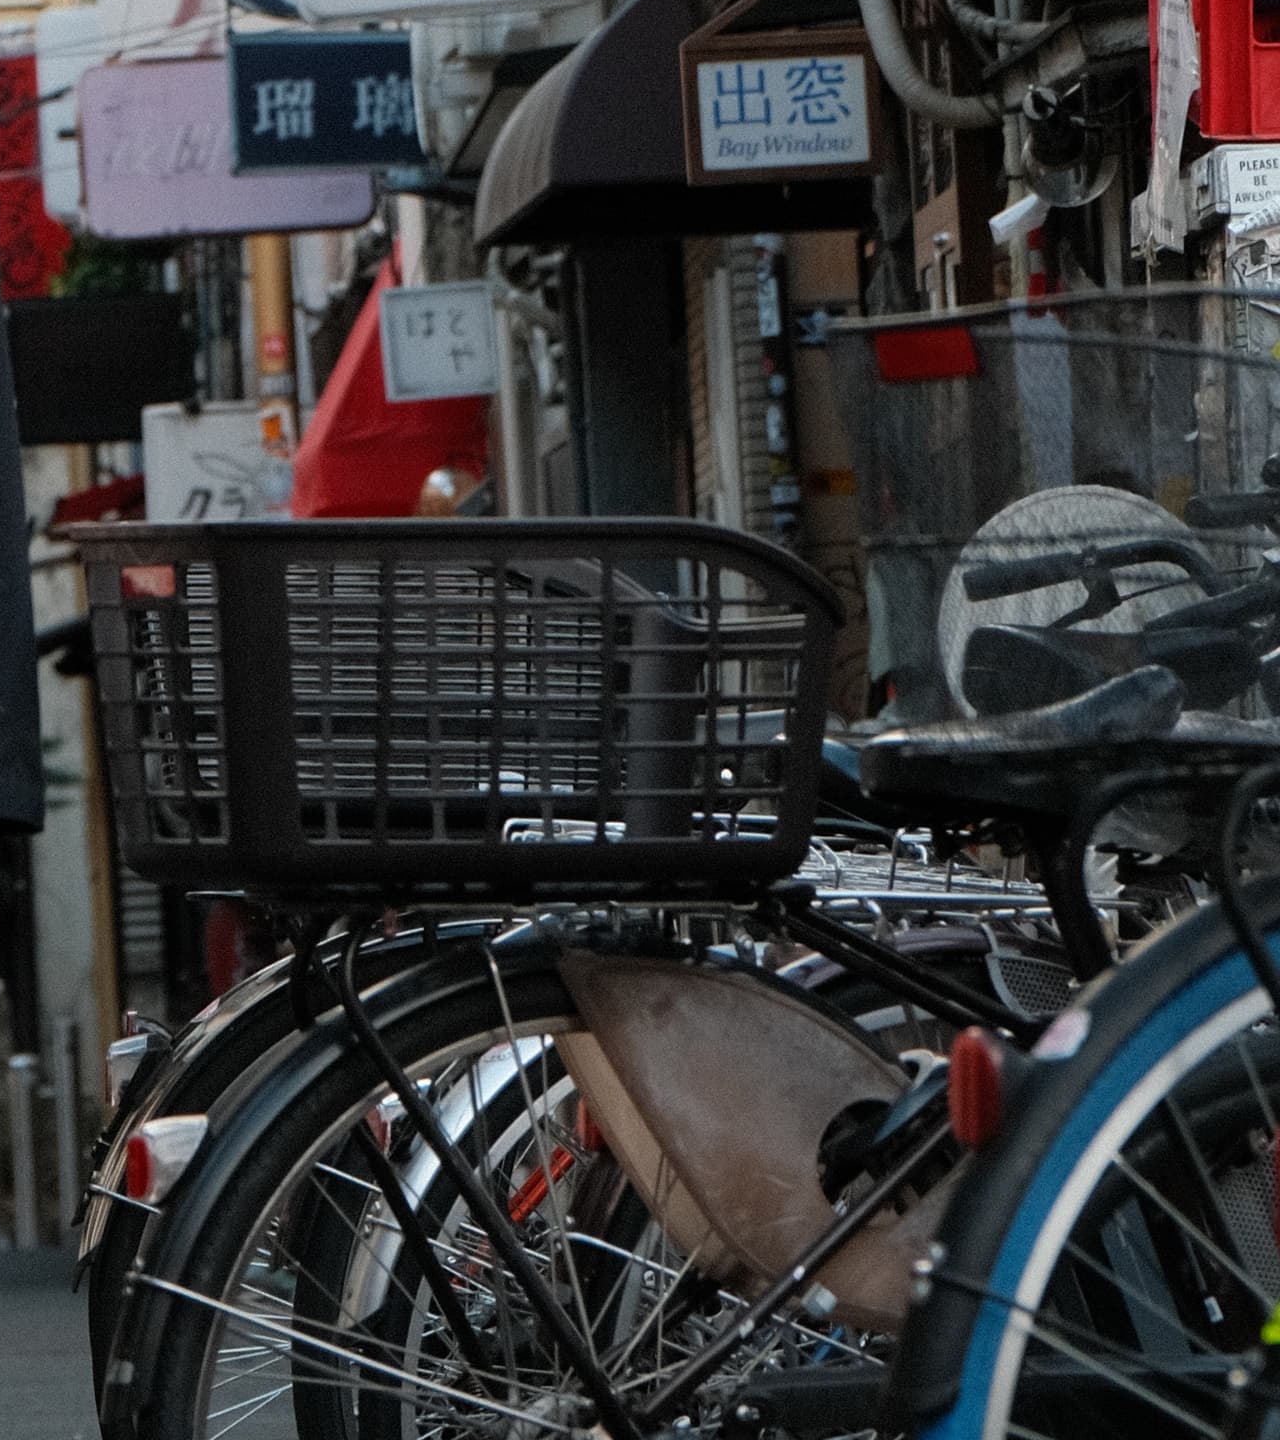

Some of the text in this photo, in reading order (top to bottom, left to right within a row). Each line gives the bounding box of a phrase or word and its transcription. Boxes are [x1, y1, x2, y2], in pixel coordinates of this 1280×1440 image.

[712, 58, 852, 130] 出窓
[718, 133, 853, 161] Bay Window
[1239, 158, 1279, 172] PLEASE
[1253, 175, 1269, 187] BE
